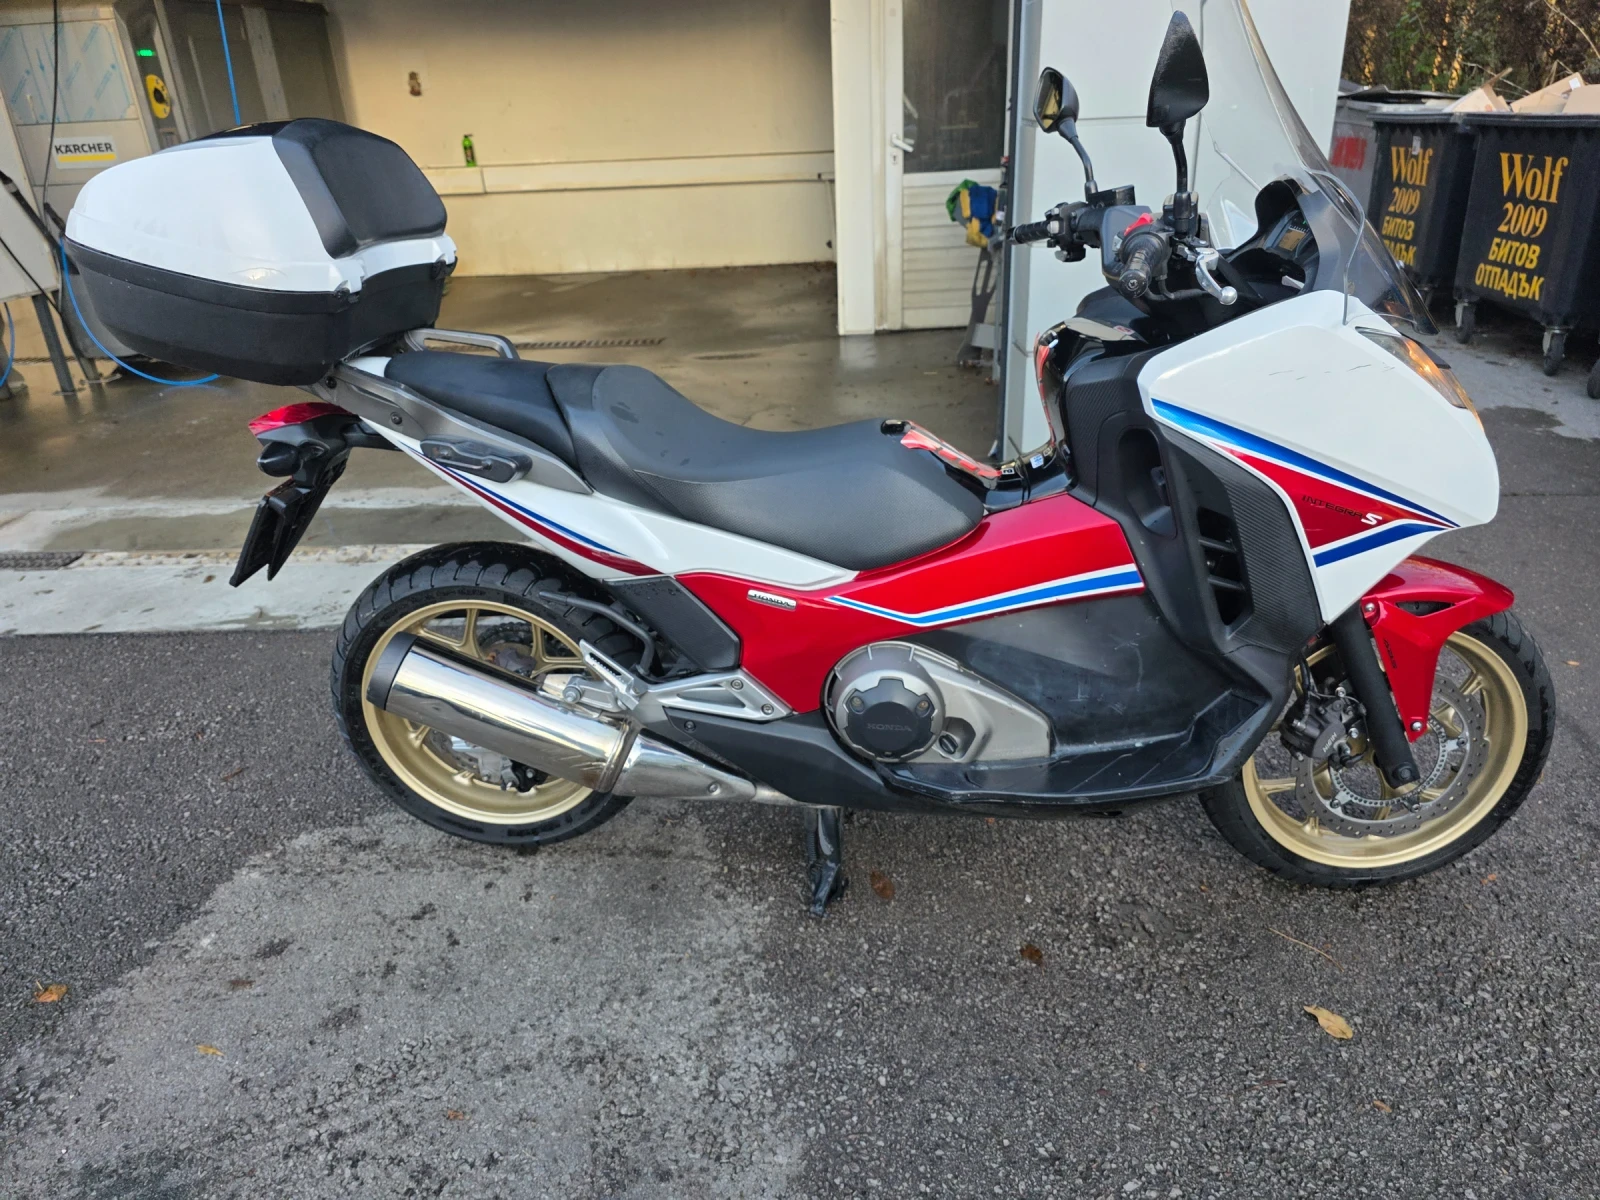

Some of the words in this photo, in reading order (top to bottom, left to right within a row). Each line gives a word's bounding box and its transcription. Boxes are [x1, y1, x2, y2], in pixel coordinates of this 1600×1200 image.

[1390, 145, 1433, 186] Wolf
[1499, 151, 1569, 204] Wolf
[1387, 187, 1421, 215] 2009
[1497, 203, 1548, 239] 2009
[1487, 236, 1542, 270] БИТОВ
[1475, 263, 1545, 301] ОТПАДЪК
[1301, 495, 1362, 519] INTEGRA
[1360, 512, 1383, 526] S
[750, 592, 792, 610] HONDA
[866, 722, 913, 733] HONDA
